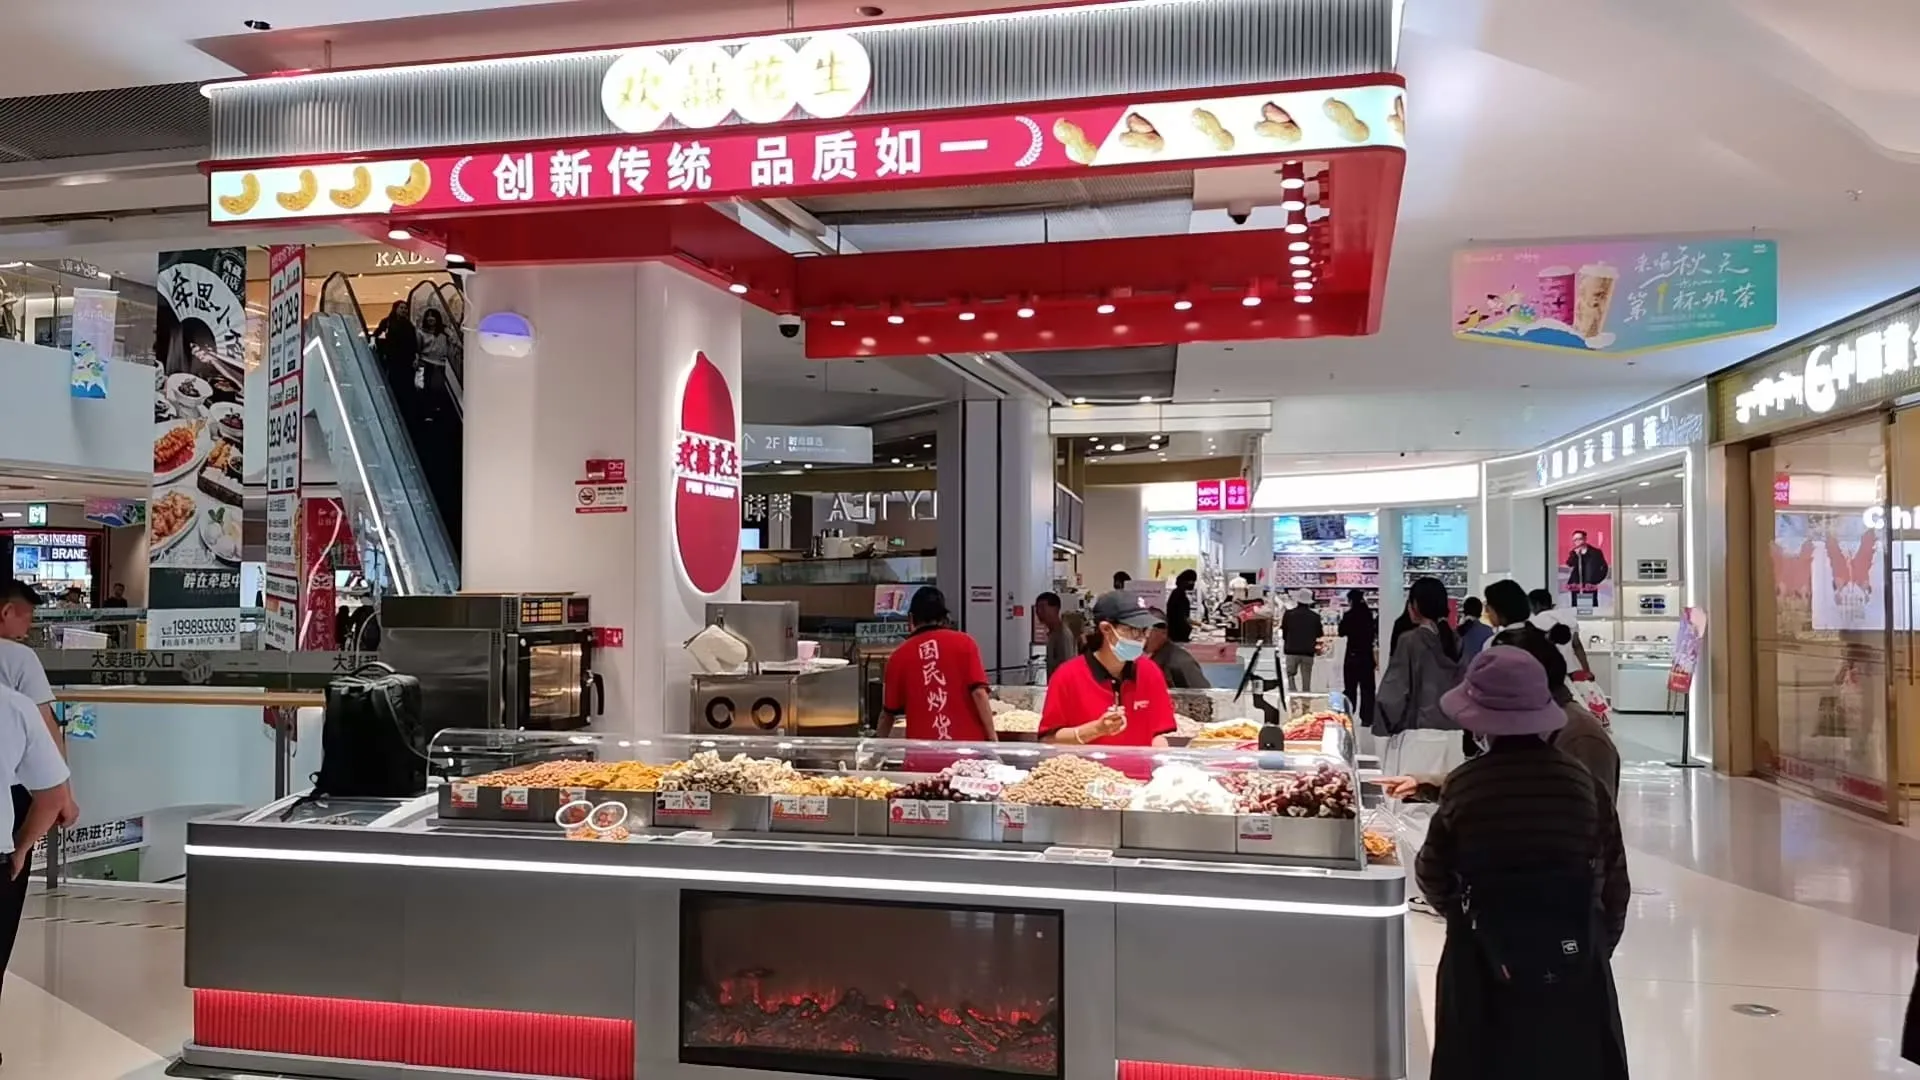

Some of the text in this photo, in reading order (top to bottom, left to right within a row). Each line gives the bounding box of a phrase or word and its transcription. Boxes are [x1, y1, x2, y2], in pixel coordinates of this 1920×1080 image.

[493, 127, 989, 202] 创新传统 品质如一
[765, 436, 780, 449] 2F
[38, 534, 86, 546] SKINCARE
[91, 651, 175, 668] 大麦超市入口
